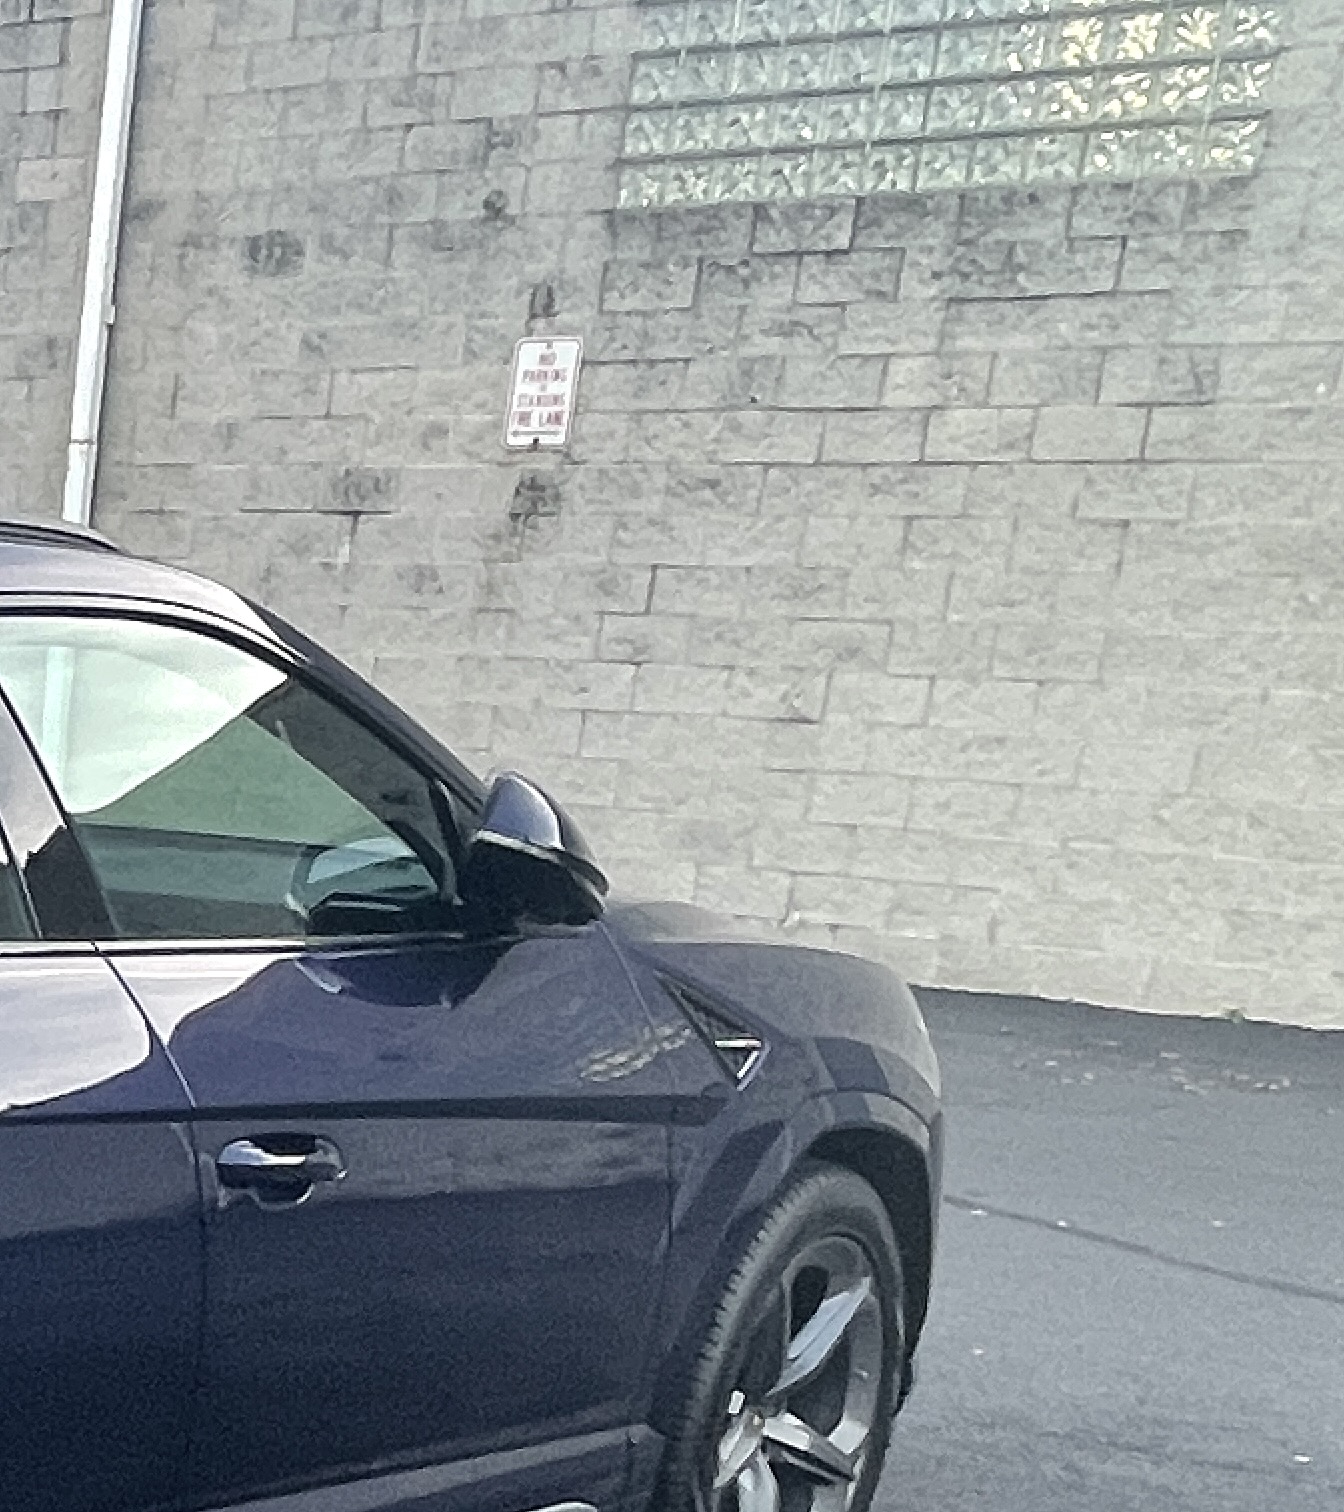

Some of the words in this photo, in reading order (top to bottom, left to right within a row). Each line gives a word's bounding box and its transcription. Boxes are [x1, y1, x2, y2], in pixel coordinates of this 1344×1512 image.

[538, 351, 558, 366] NO
[522, 368, 568, 383] PARKING
[516, 393, 566, 407] STANDING
[512, 410, 533, 427] FIRE
[538, 410, 565, 427] LANE
